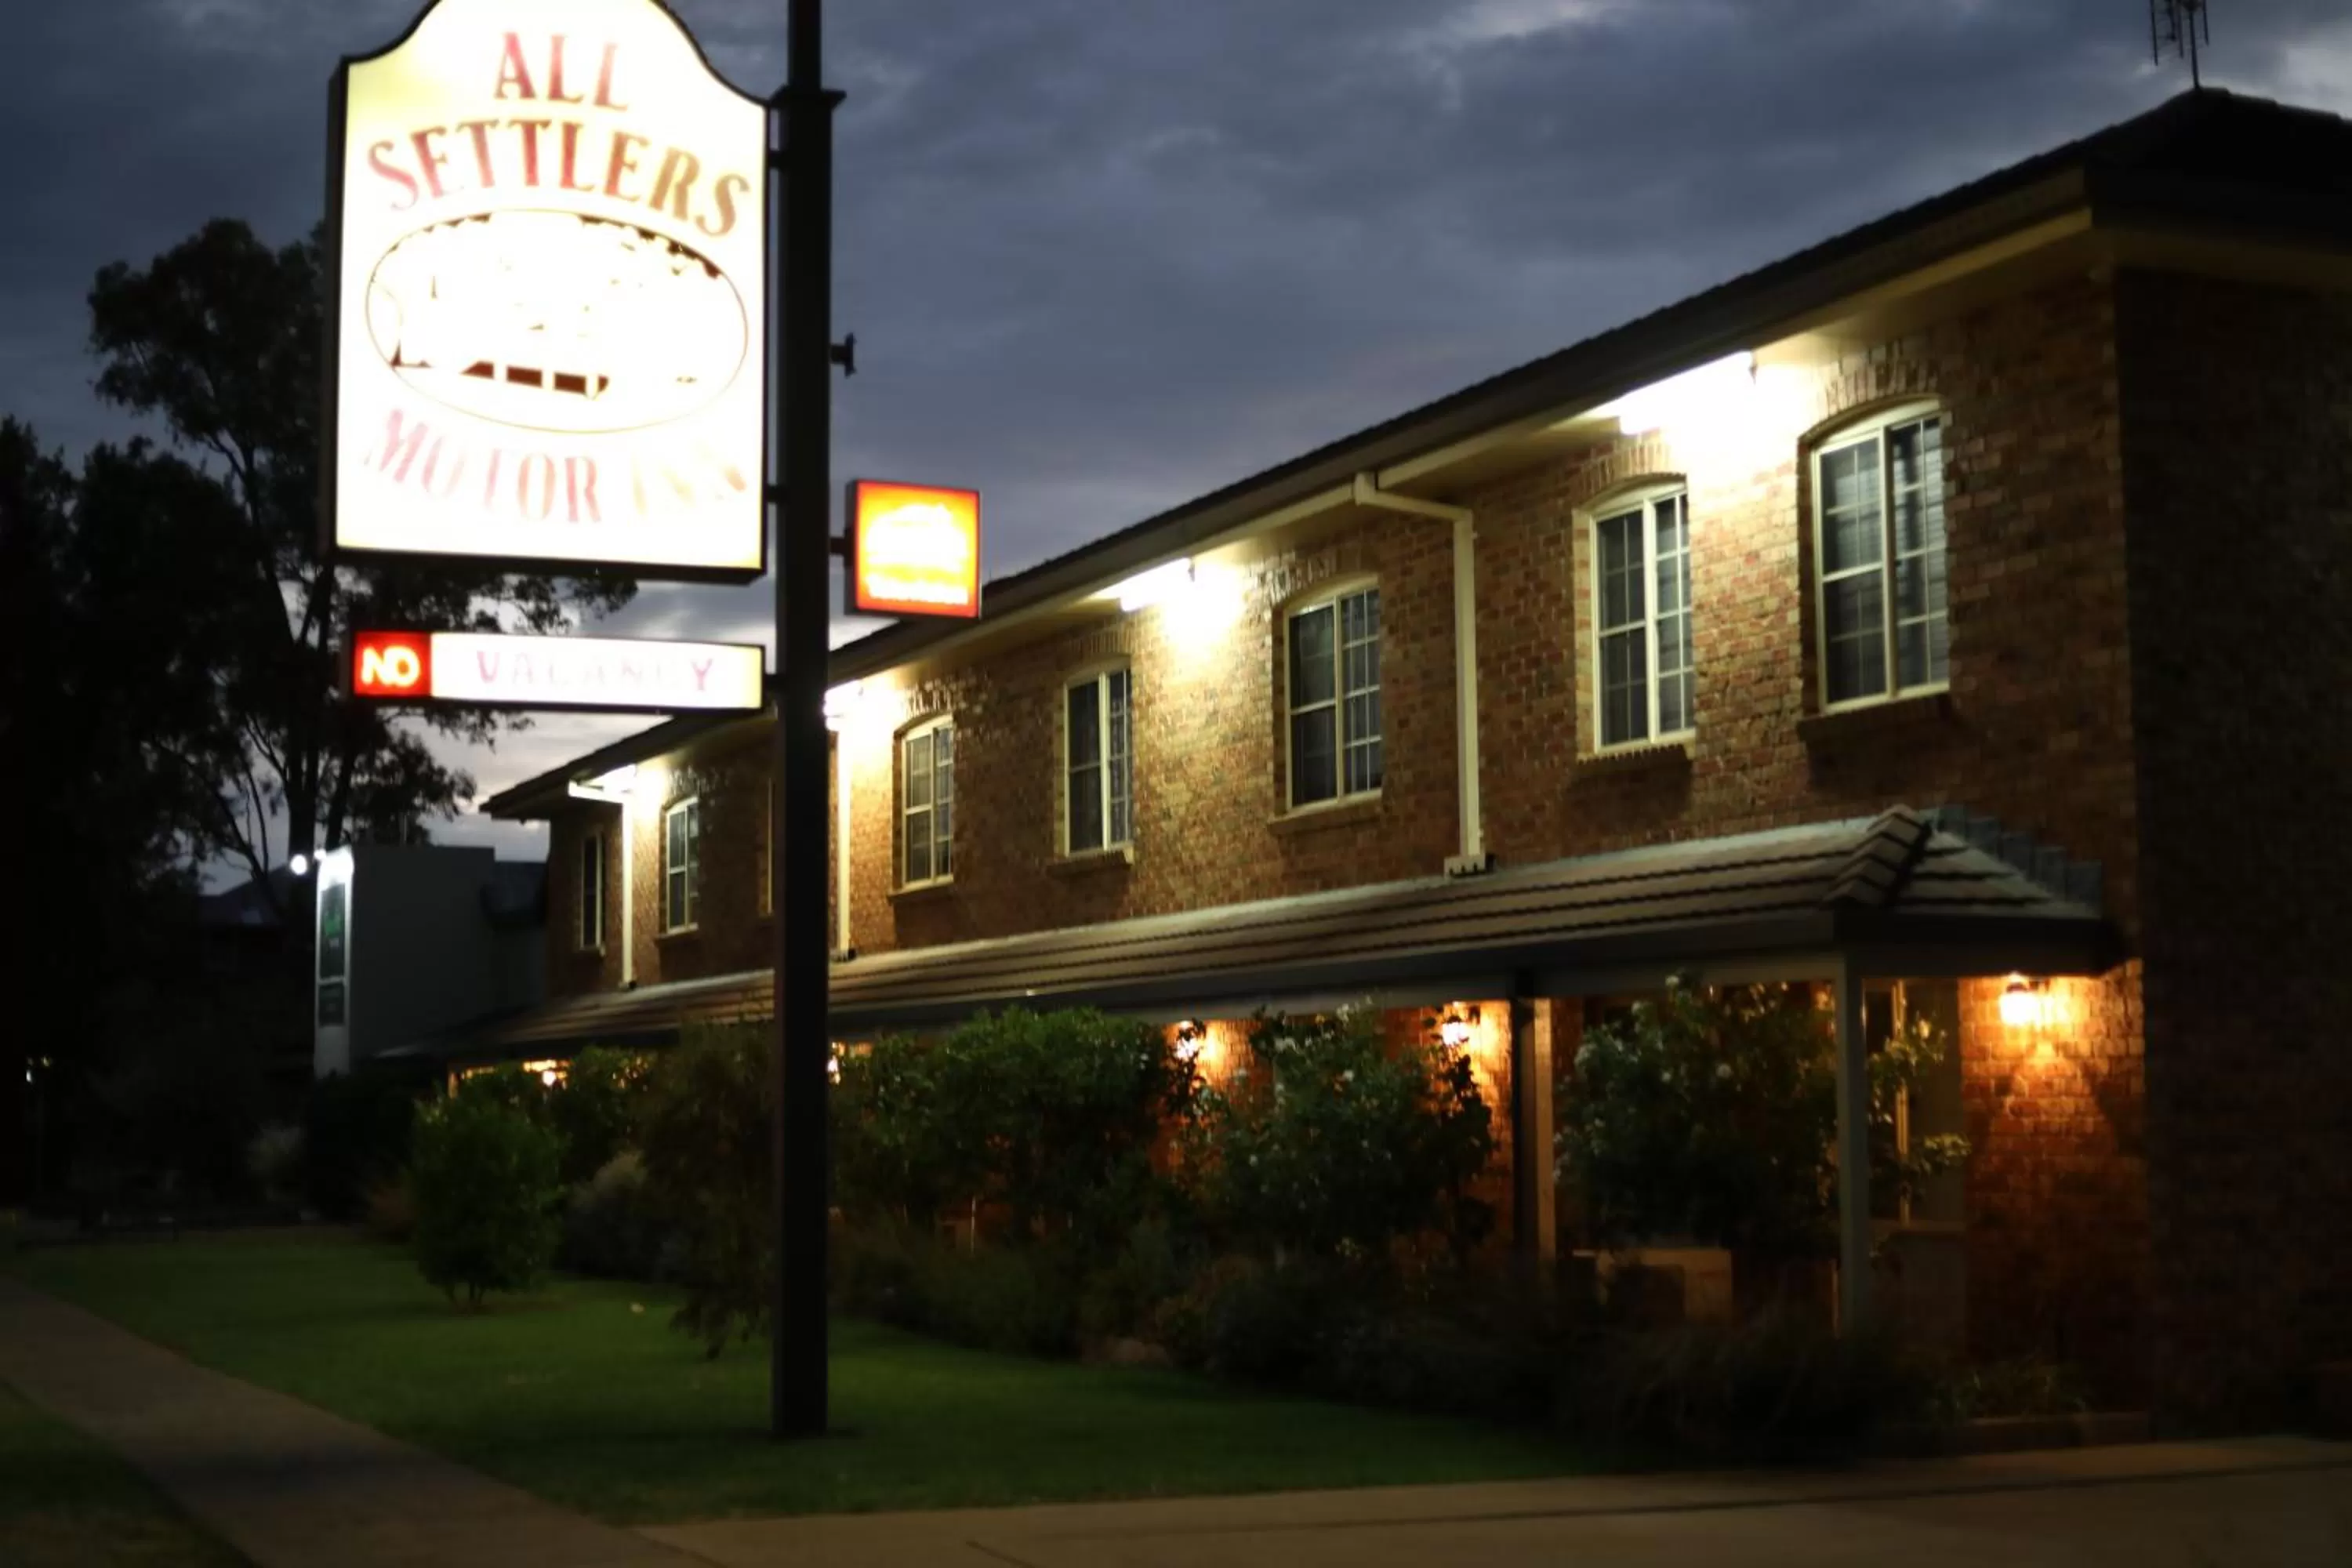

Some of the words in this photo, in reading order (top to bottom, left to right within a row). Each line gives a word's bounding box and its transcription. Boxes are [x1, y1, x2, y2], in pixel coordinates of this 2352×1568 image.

[493, 31, 629, 111] ALL
[367, 118, 750, 237] SETTLERS
[361, 644, 421, 688] NO
[476, 650, 713, 691] VACANY
